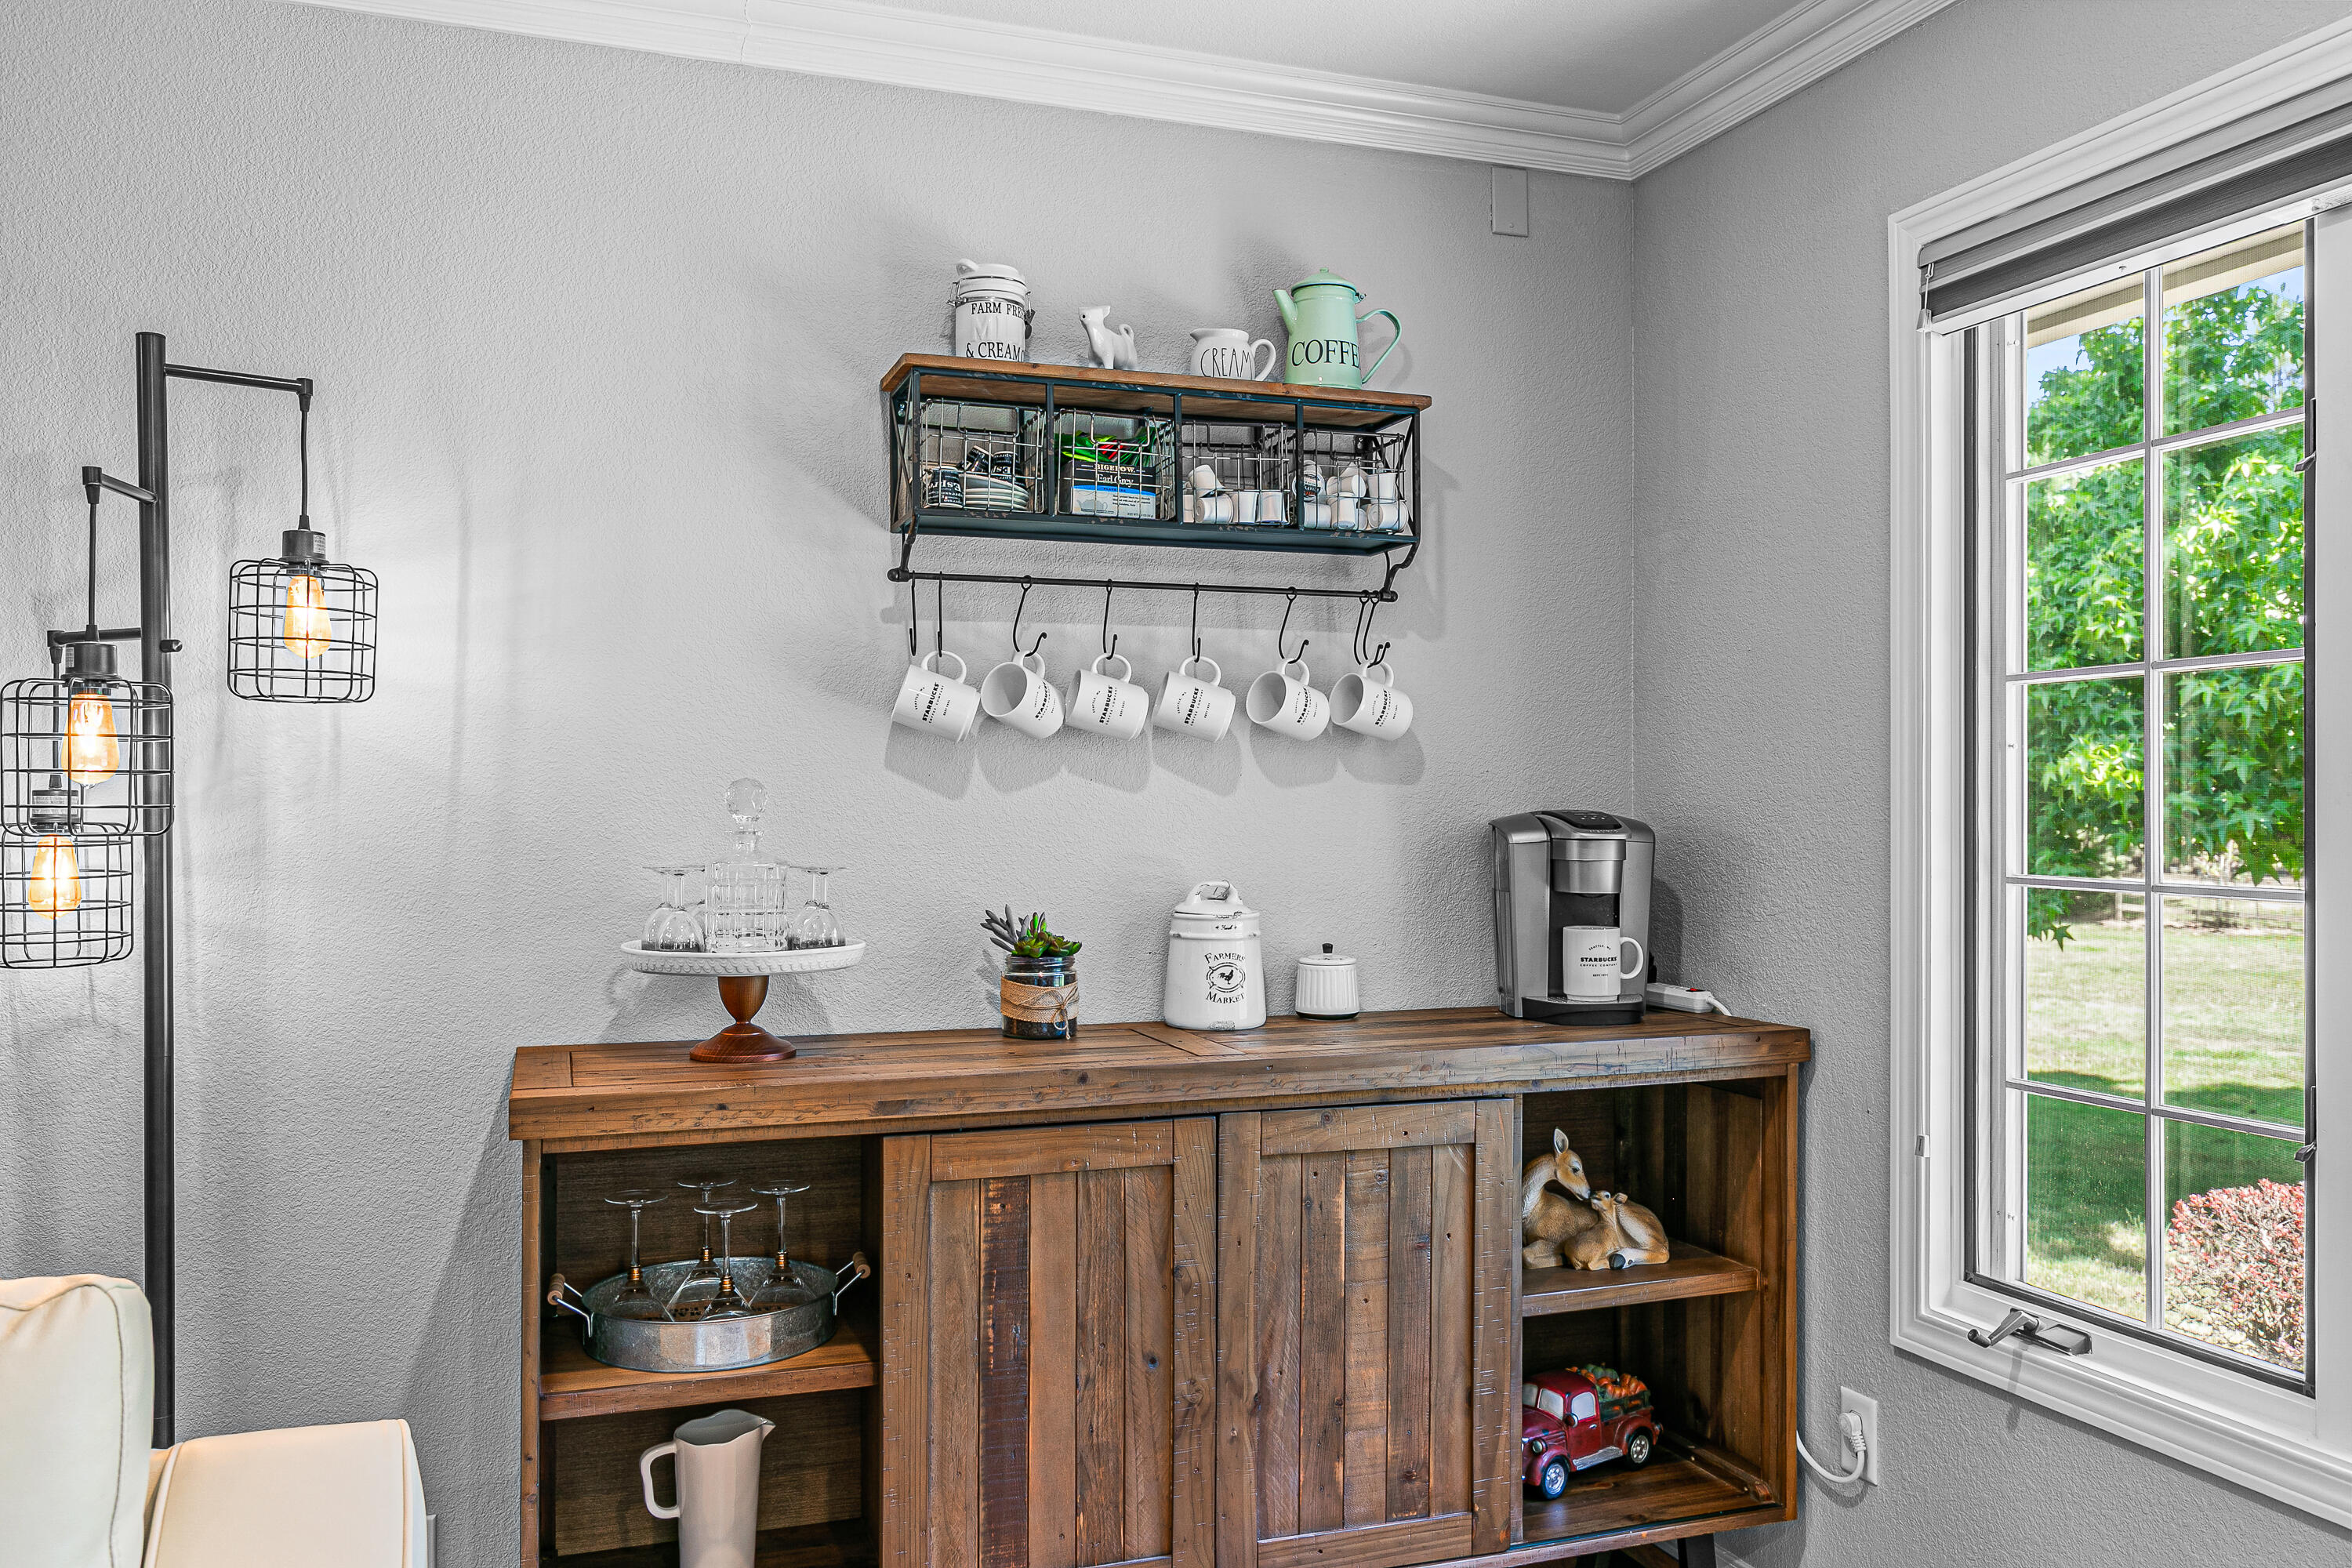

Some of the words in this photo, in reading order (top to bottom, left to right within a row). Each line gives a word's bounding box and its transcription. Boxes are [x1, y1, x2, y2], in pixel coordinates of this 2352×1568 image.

[971, 302, 1002, 315] FARM
[966, 343, 975, 358] &
[1200, 347, 1253, 380] CREAM
[1291, 339, 1361, 370] COFFE
[1098, 474, 1113, 482] Earl
[922, 683, 939, 721] STARBUCKS
[1099, 685, 1113, 724] STARBUCKS
[1184, 688, 1200, 724] STARBUCKS
[1206, 991, 1245, 1004] MARKET
